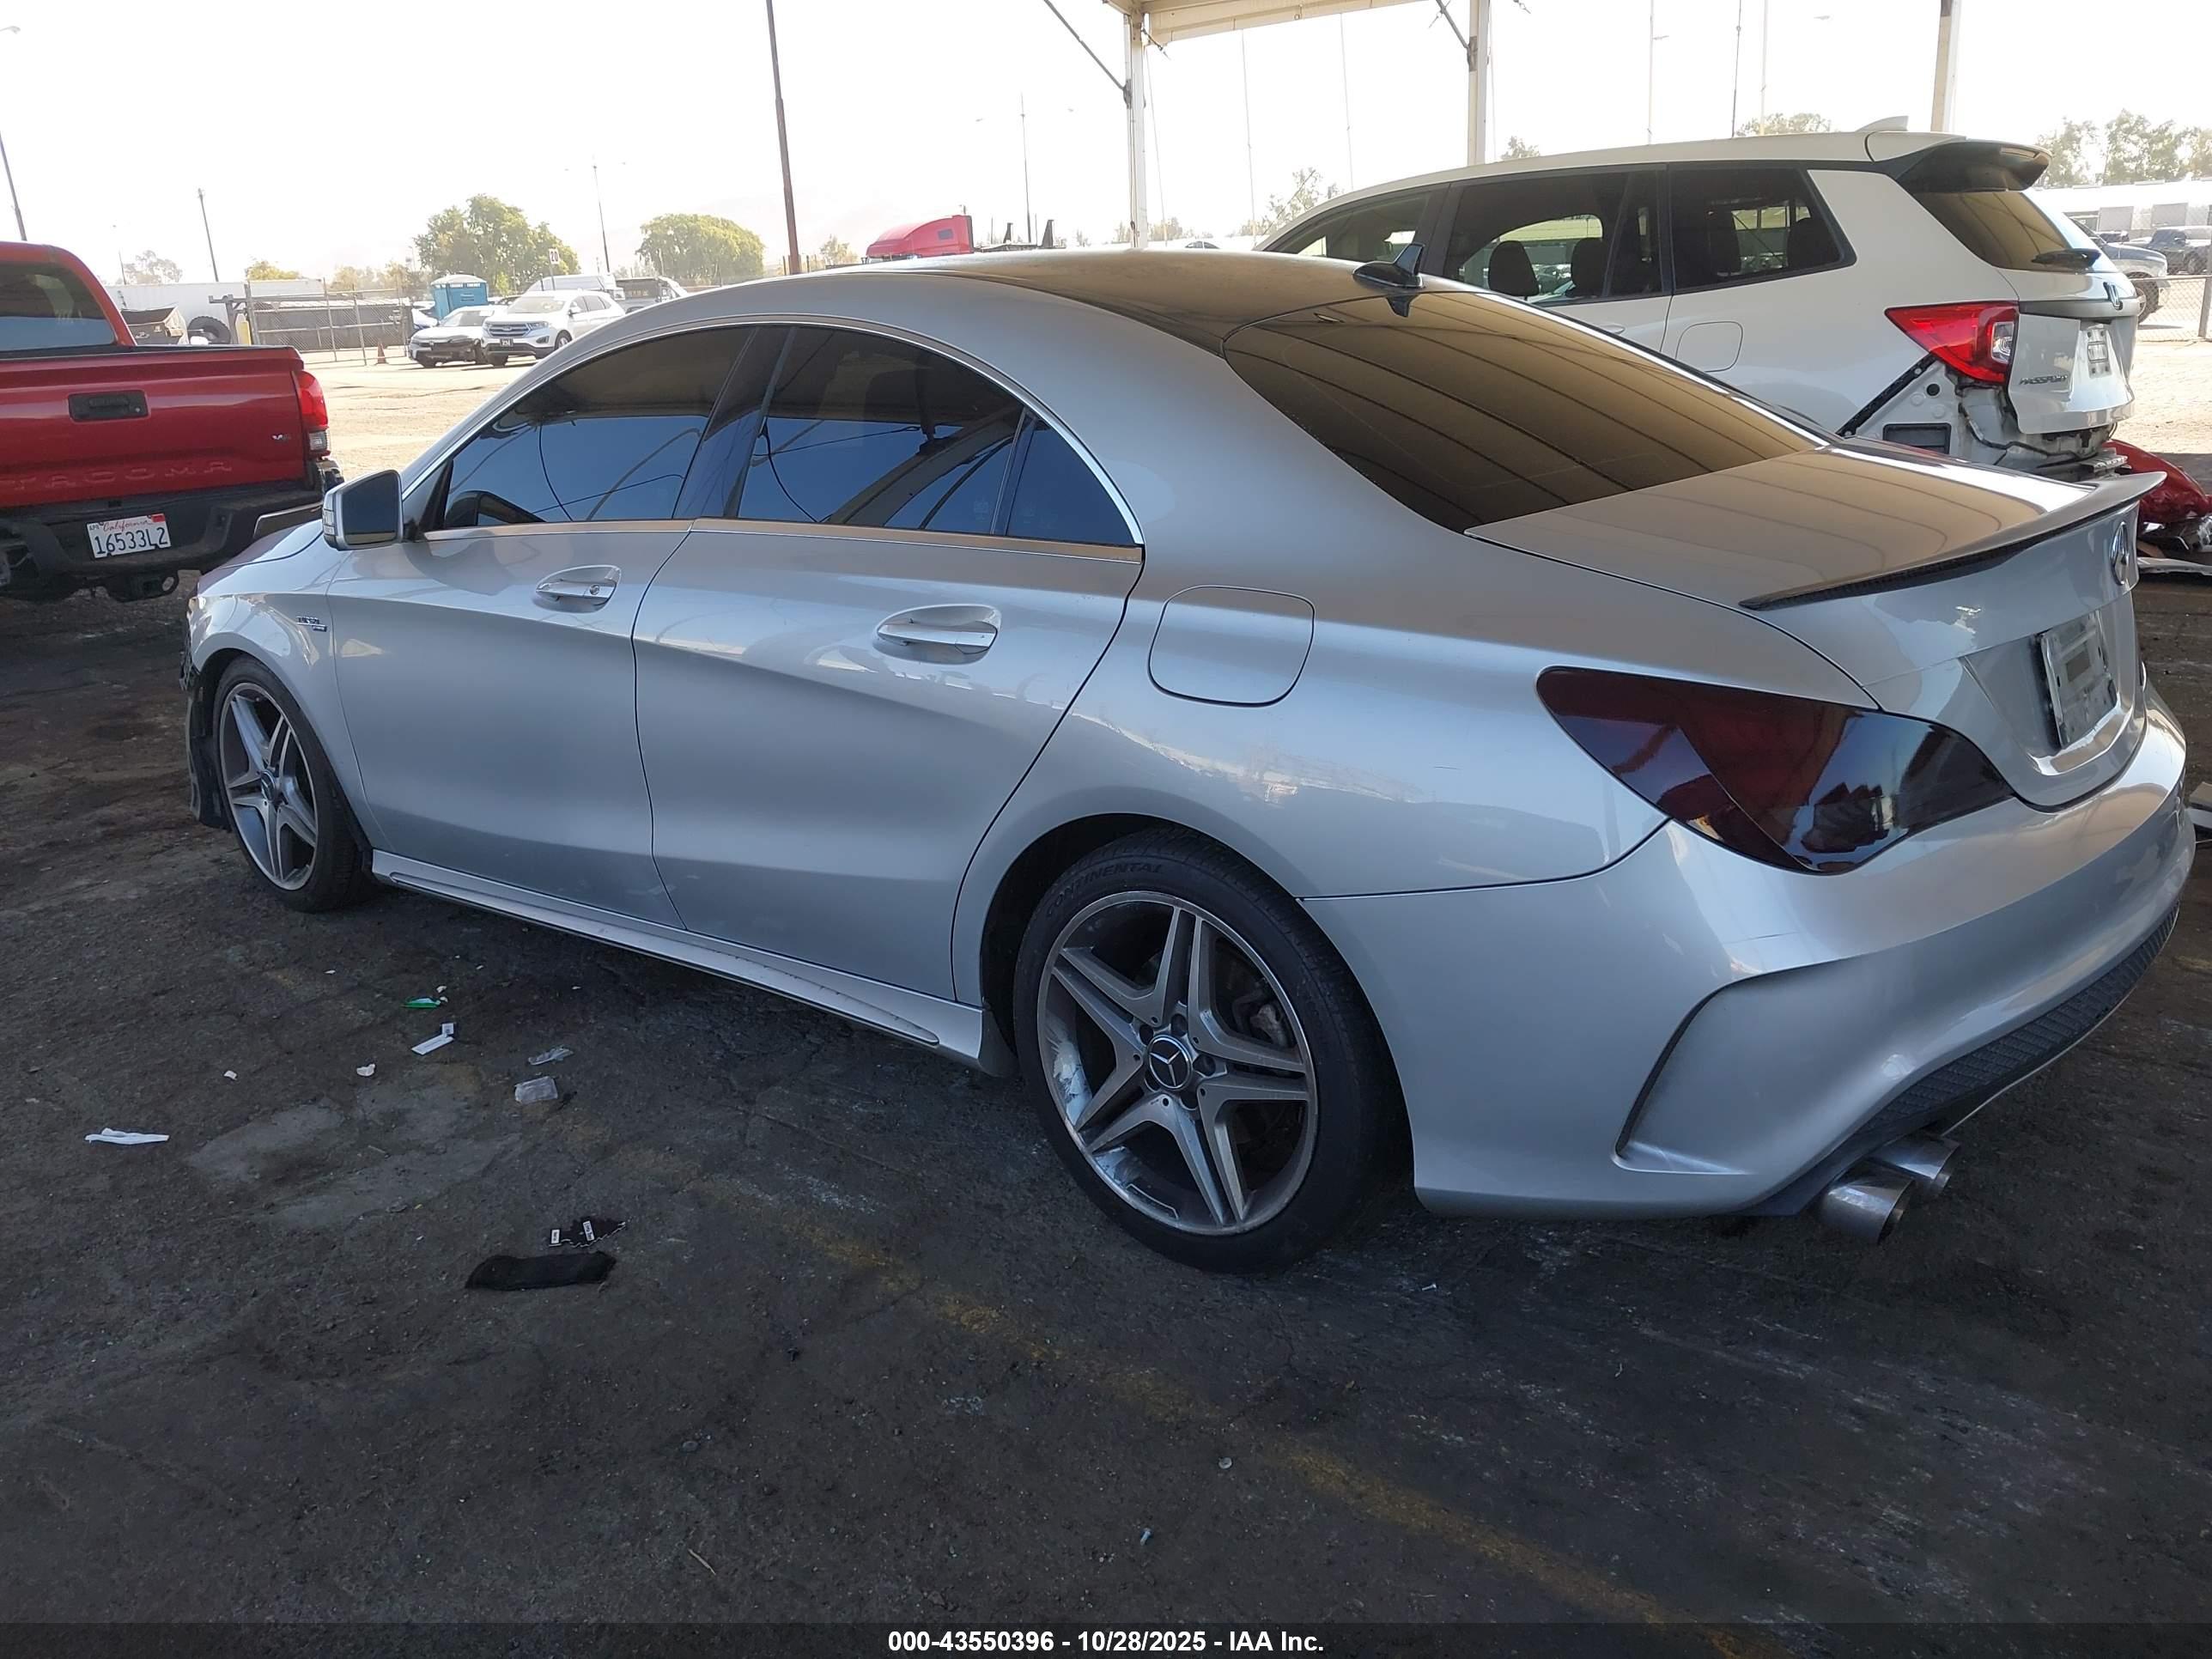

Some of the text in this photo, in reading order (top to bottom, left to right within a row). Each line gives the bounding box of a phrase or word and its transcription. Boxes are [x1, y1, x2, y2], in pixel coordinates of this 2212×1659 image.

[550, 251, 559, 262] 20
[2020, 374, 2068, 385] PASSPORT
[0, 462, 232, 490] TACOMA
[103, 520, 153, 532] California
[94, 526, 168, 555] 16533L2
[1046, 862, 1164, 920] CONTINENTAL
